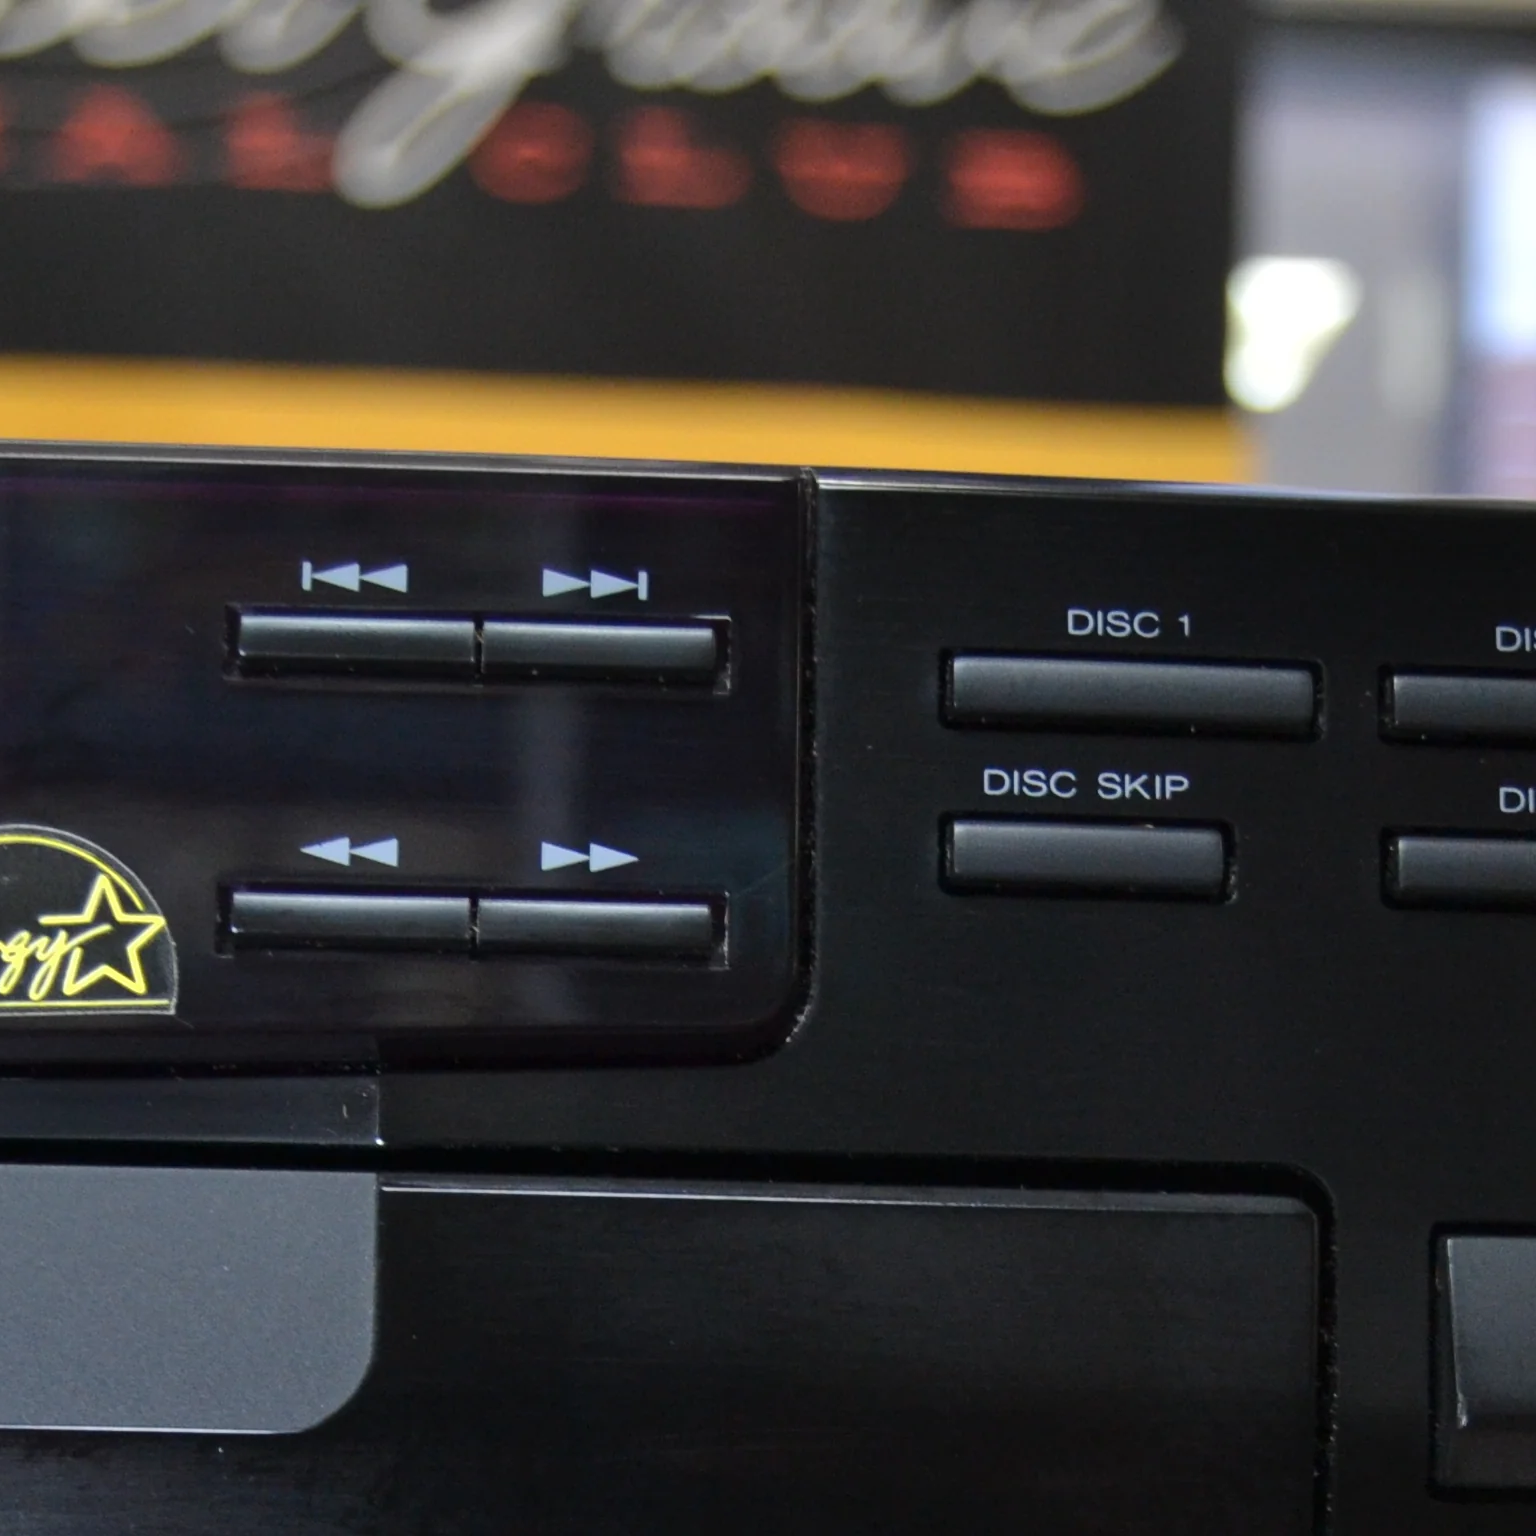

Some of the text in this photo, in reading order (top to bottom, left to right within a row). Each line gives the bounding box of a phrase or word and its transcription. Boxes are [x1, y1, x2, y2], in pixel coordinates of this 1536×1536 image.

[1066, 607, 1192, 639] DISC 1
[982, 767, 1191, 801] DISC SKIP
